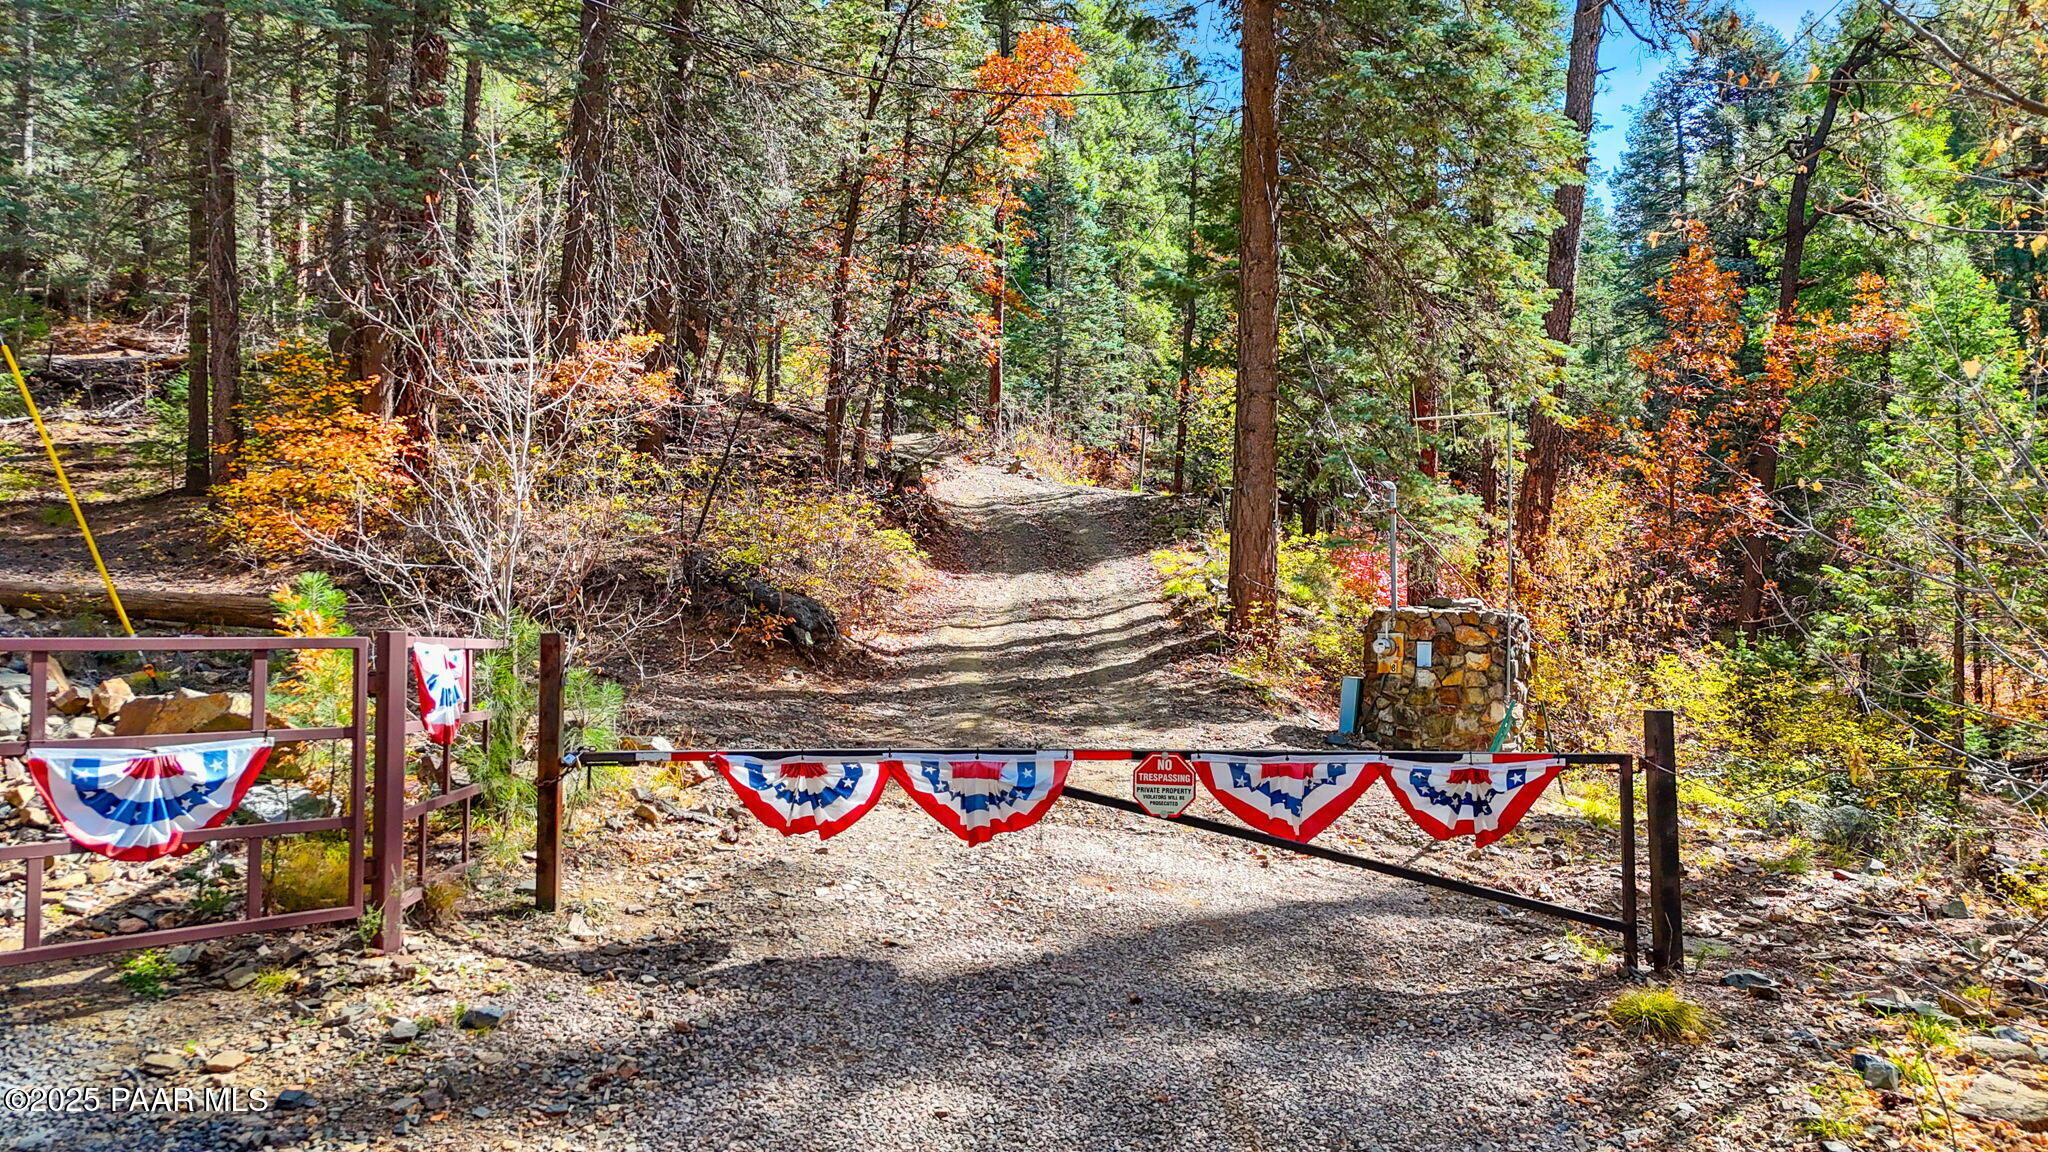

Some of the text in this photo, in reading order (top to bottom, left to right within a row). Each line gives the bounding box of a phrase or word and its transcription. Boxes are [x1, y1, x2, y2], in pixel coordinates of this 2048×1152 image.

[1157, 759, 1172, 770] NO
[1138, 772, 1191, 783] TRESPASSING
[1136, 786, 1160, 794] PRIVATE
